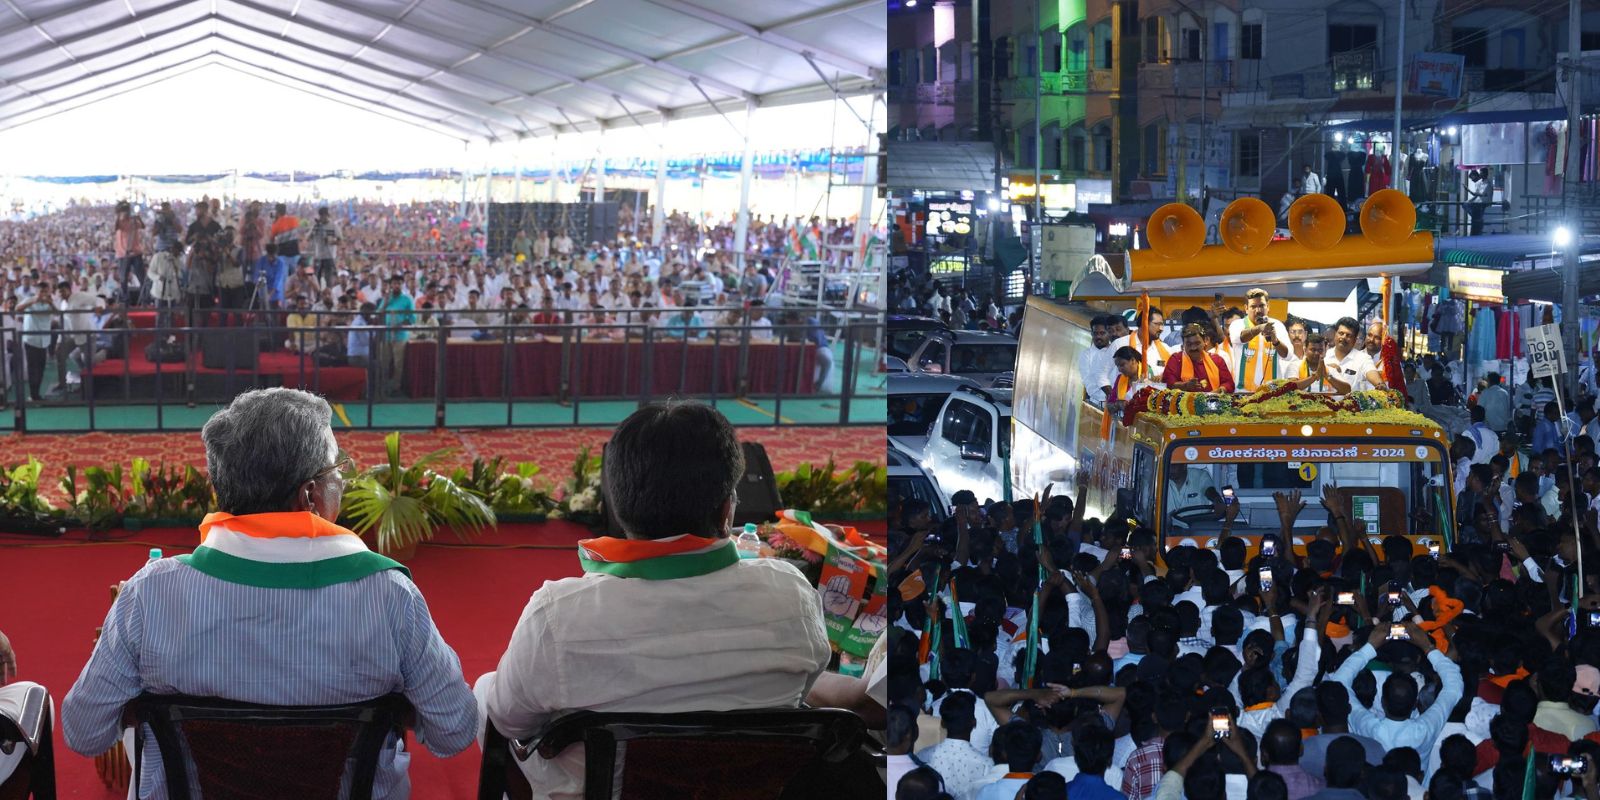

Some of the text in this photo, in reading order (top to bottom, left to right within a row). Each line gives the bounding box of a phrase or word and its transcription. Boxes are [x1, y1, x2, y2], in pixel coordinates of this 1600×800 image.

[1208, 446, 1287, 460] ಲೋಕಸಭಾ
[1291, 445, 1358, 458] ಚುನಾವಣೆ
[1372, 448, 1405, 457] 2024
[1302, 465, 1311, 479] 1
